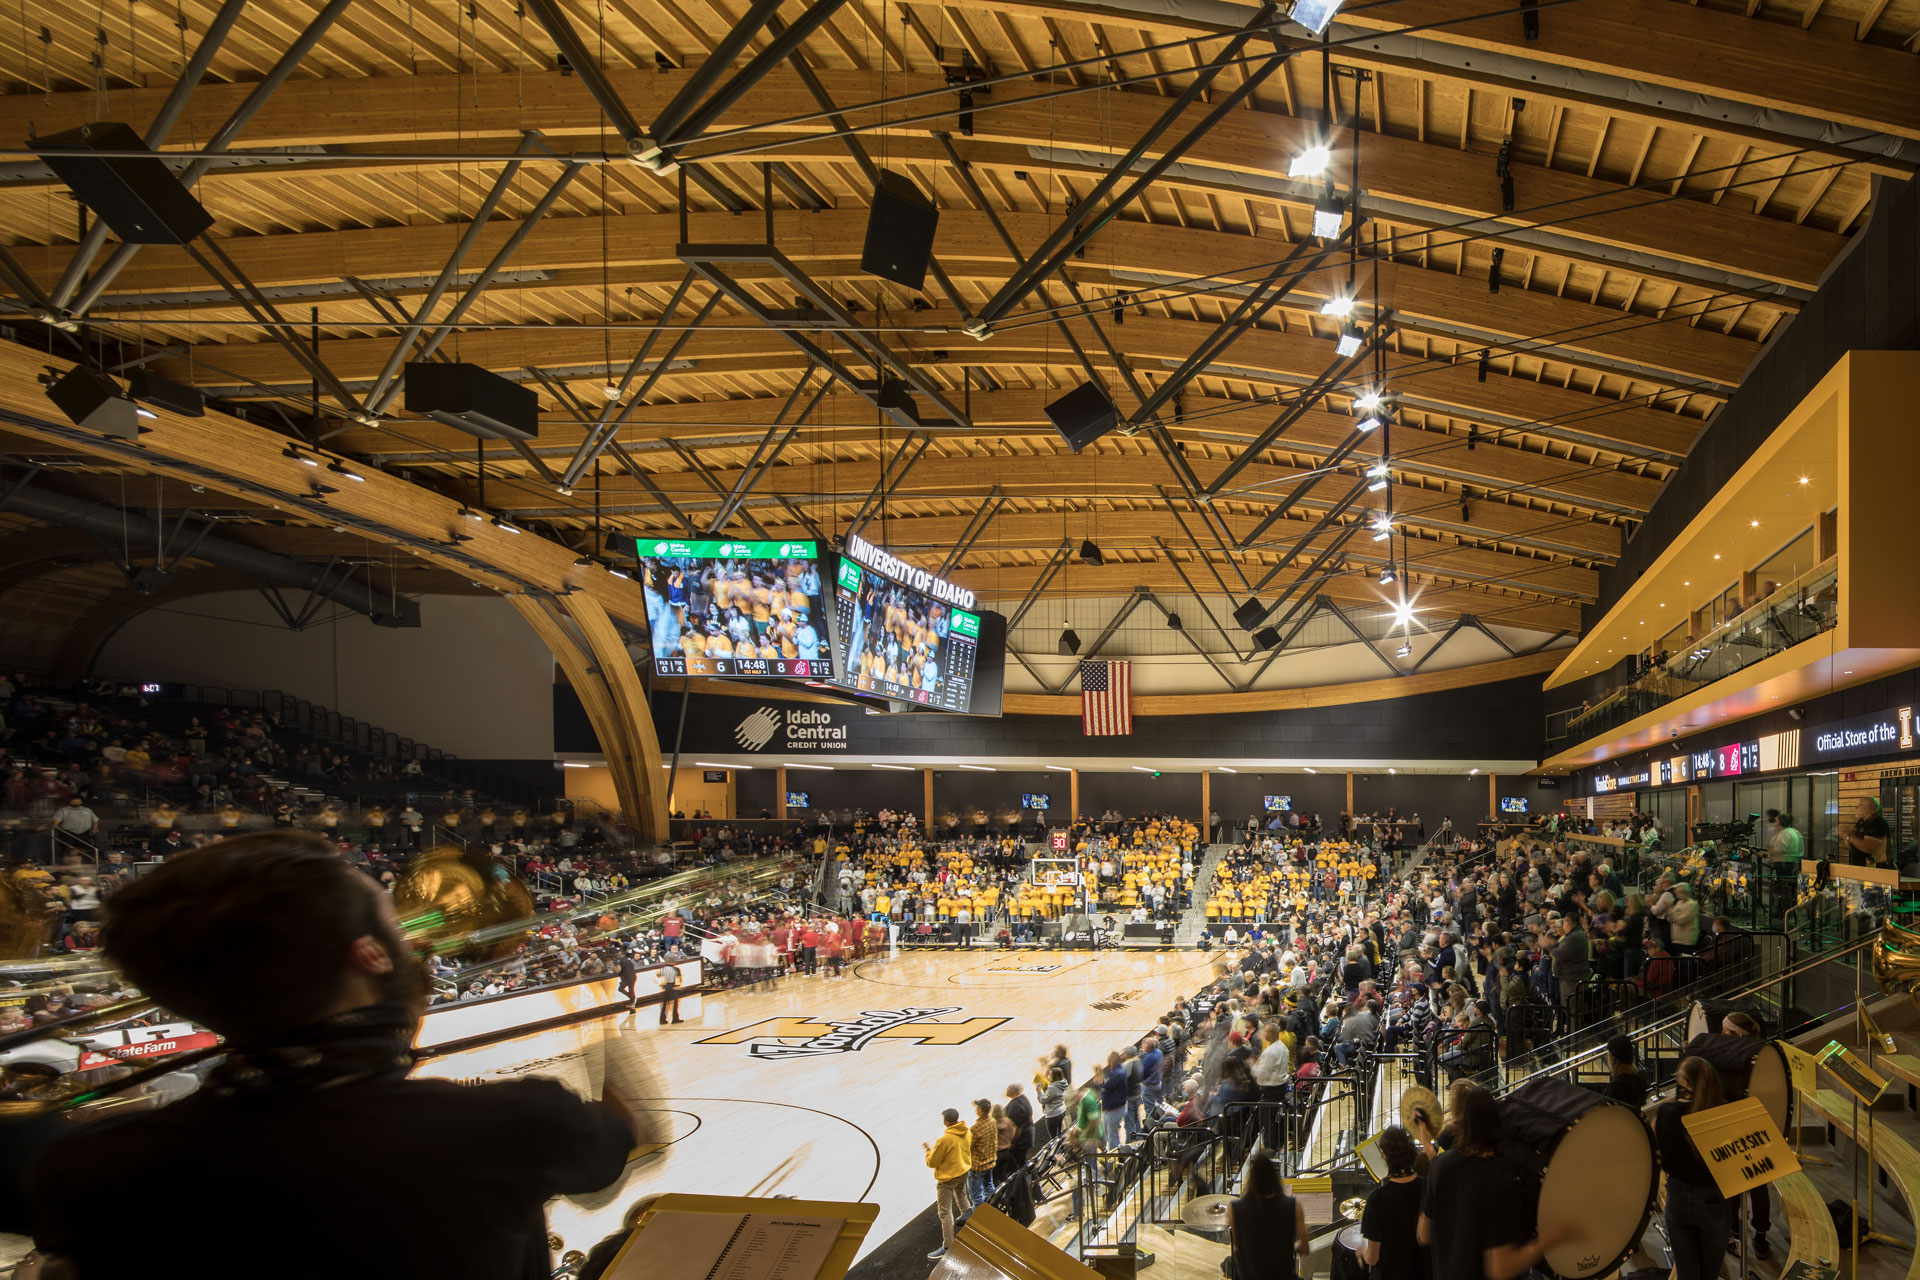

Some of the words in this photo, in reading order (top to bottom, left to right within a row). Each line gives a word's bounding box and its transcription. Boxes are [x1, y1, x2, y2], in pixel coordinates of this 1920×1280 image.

[850, 534, 916, 585] UNIVERSITY
[915, 569, 933, 592] OF
[932, 577, 974, 609] IDAHO
[716, 661, 726, 672] 6
[737, 660, 766, 670] 14:48
[777, 662, 786, 673] 8
[870, 680, 876, 690] 6
[885, 682, 900, 693] 14:48
[909, 689, 915, 698] 8
[786, 709, 831, 724] Idaho
[786, 725, 847, 739] Central
[1817, 731, 1845, 752] Official
[1845, 730, 1867, 747] Store
[1868, 724, 1879, 743] of
[1879, 722, 1896, 741] the
[1694, 752, 1710, 770] 14:48
[1719, 753, 1725, 771] 8
[1742, 756, 1748, 769] 4
[1752, 755, 1758, 767] 2
[1681, 761, 1687, 777] 6
[1053, 838, 1066, 848] 30
[1709, 1129, 1771, 1162] UNIVERSITY
[1741, 1156, 1775, 1180] IDAHO
